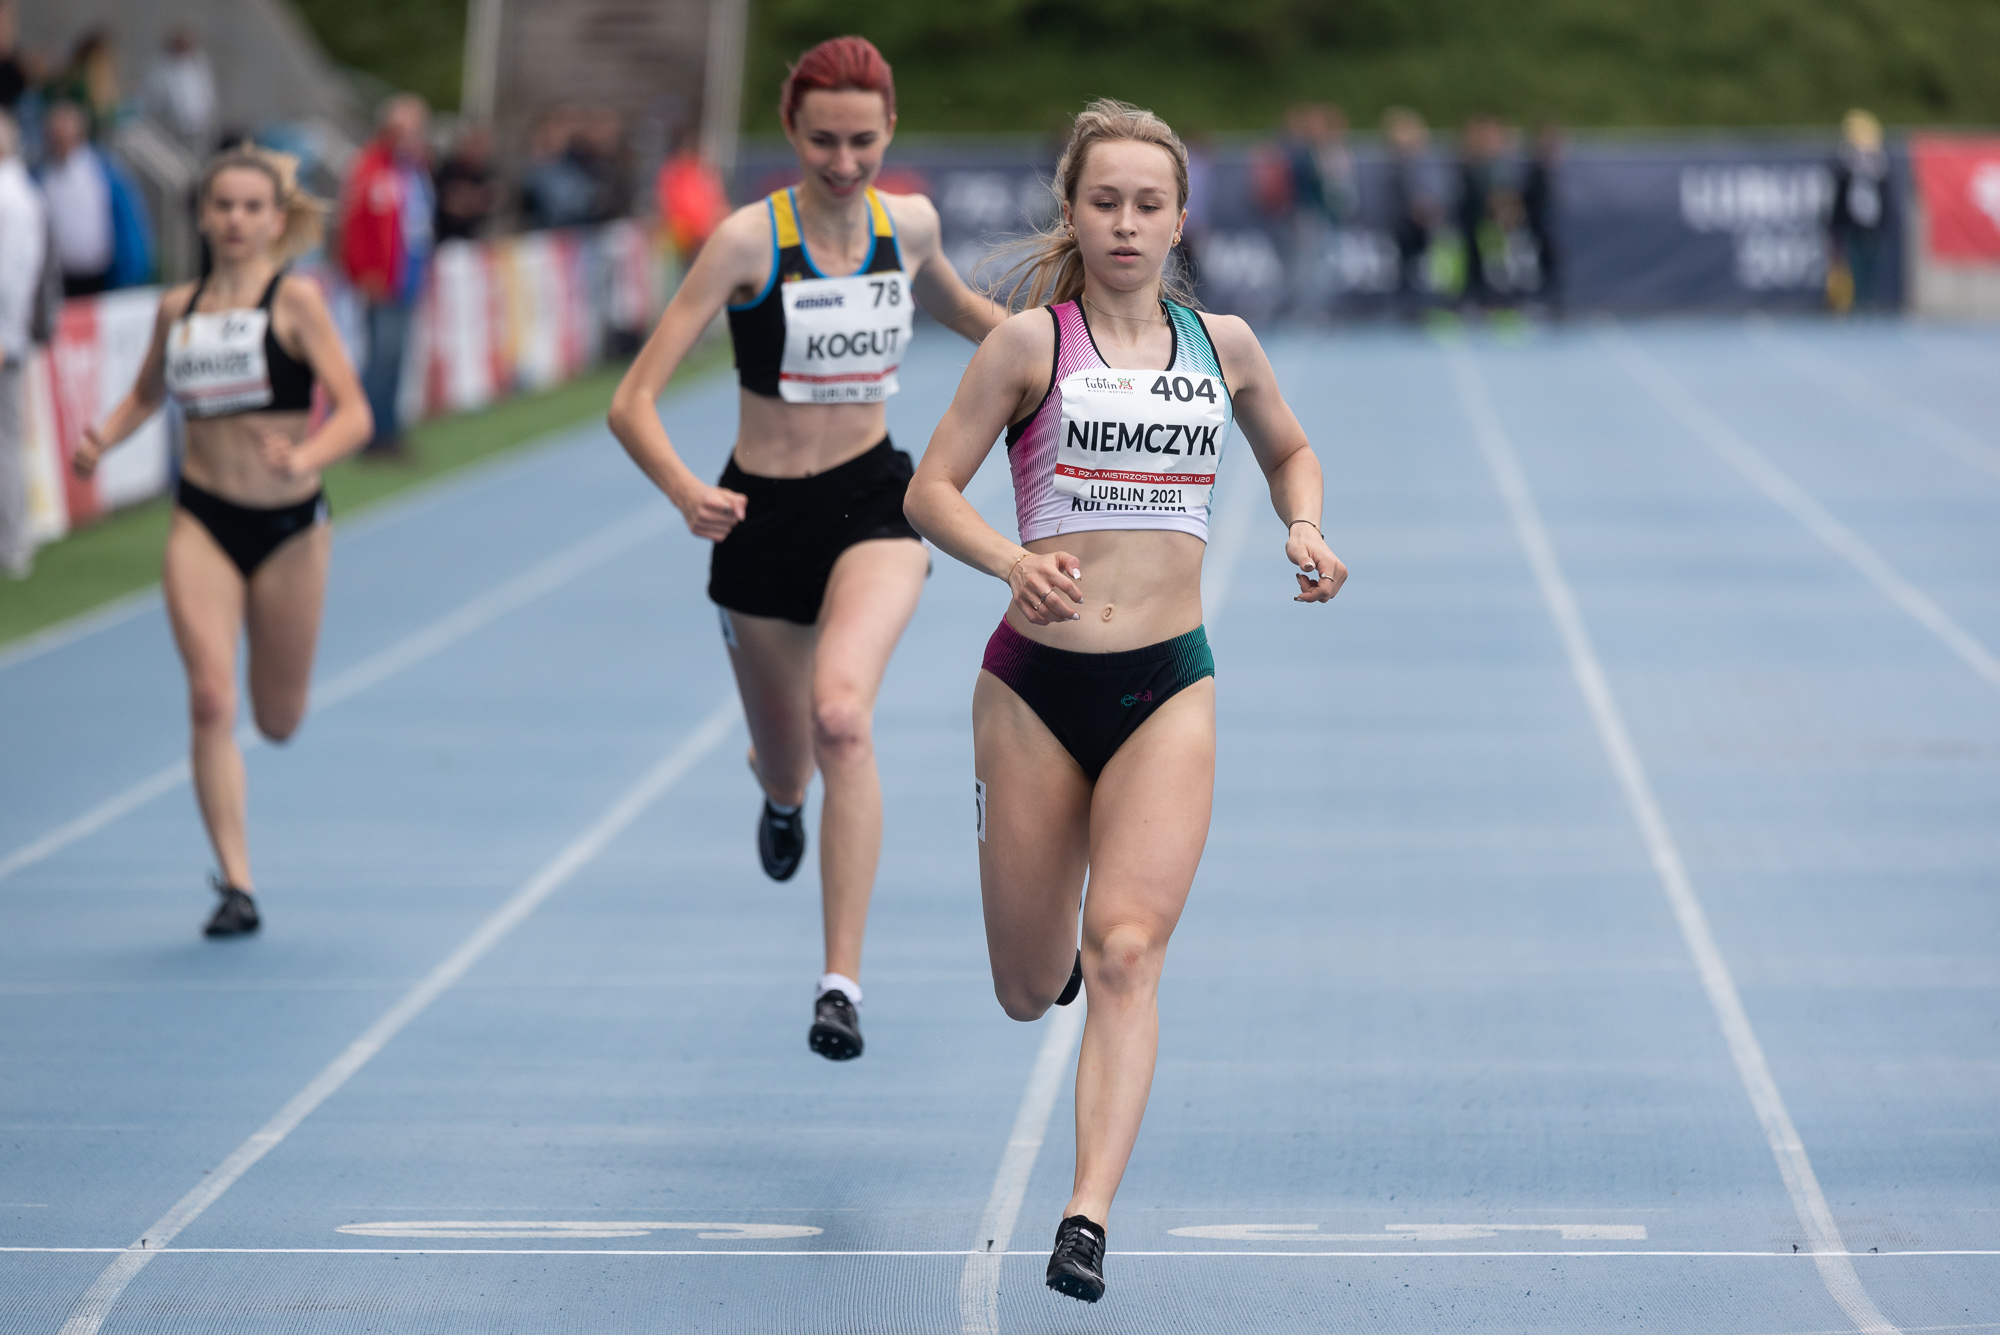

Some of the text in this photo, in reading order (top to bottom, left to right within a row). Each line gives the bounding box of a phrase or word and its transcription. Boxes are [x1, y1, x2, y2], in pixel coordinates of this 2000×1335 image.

[869, 280, 900, 308] 78
[806, 327, 899, 360] KOGUT
[1150, 375, 1217, 404] 404
[1067, 420, 1218, 456] NIEMCZYK
[1101, 472, 1165, 482] MISTRZOSTWA
[1090, 485, 1182, 503] LUBLIN 2021
